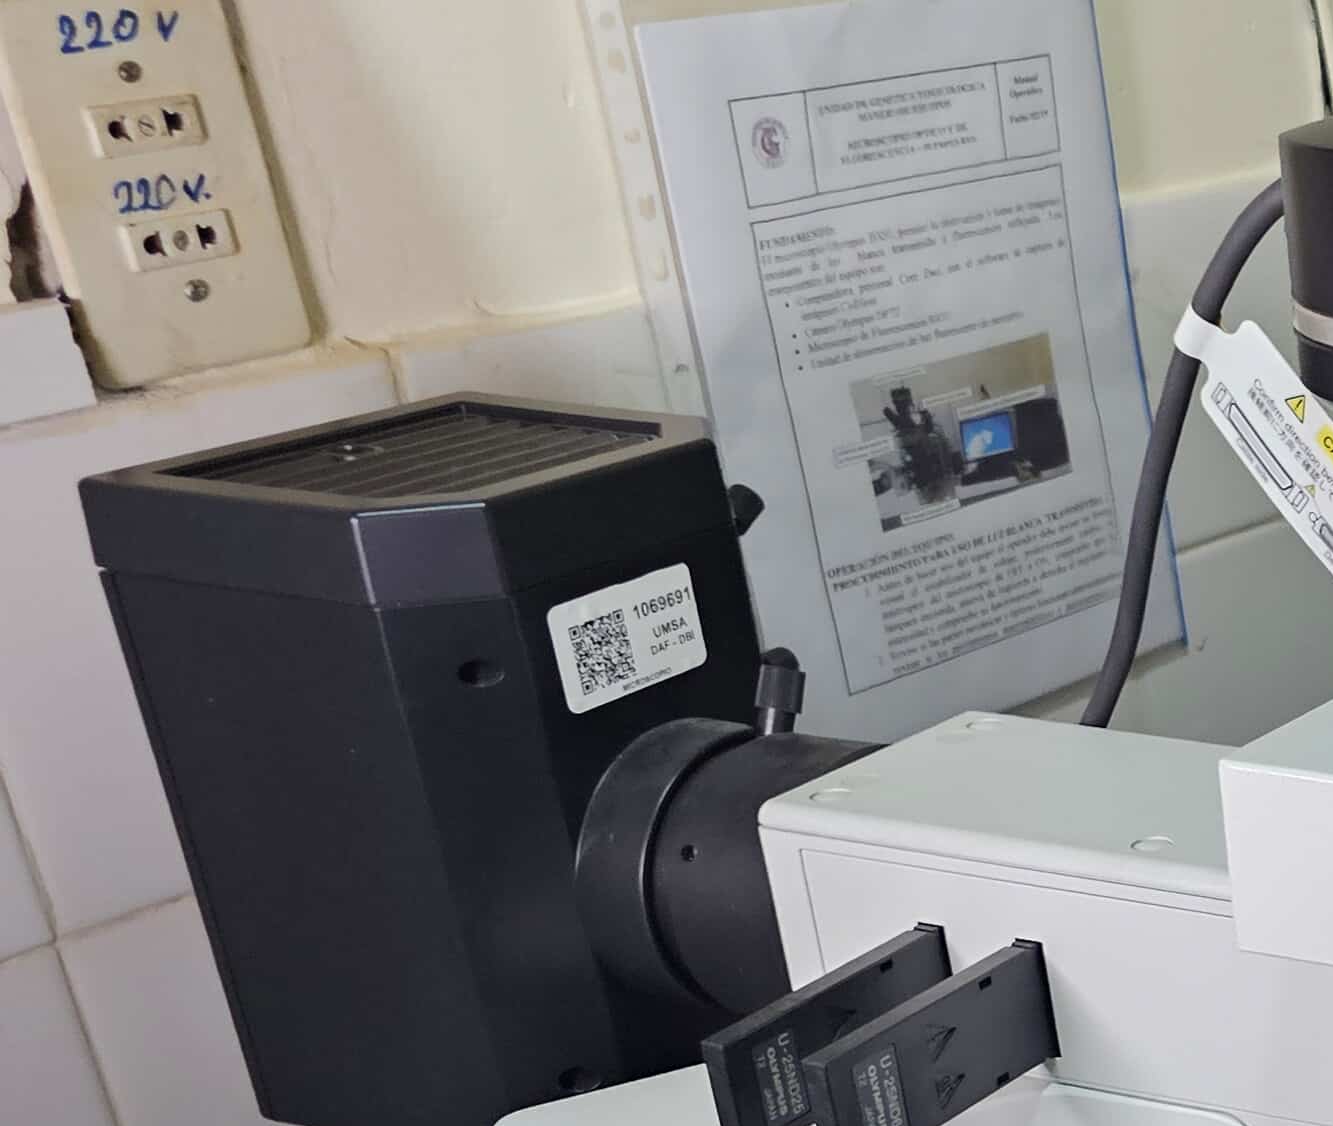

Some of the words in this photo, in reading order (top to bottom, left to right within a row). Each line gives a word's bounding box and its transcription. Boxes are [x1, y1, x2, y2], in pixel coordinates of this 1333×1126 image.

[59, 10, 139, 53] 220
[115, 174, 174, 213] 220
[1283, 422, 1321, 469] direction
[632, 585, 691, 620] 1069691
[651, 616, 688, 638] UMSA
[649, 639, 670, 656] DAF
